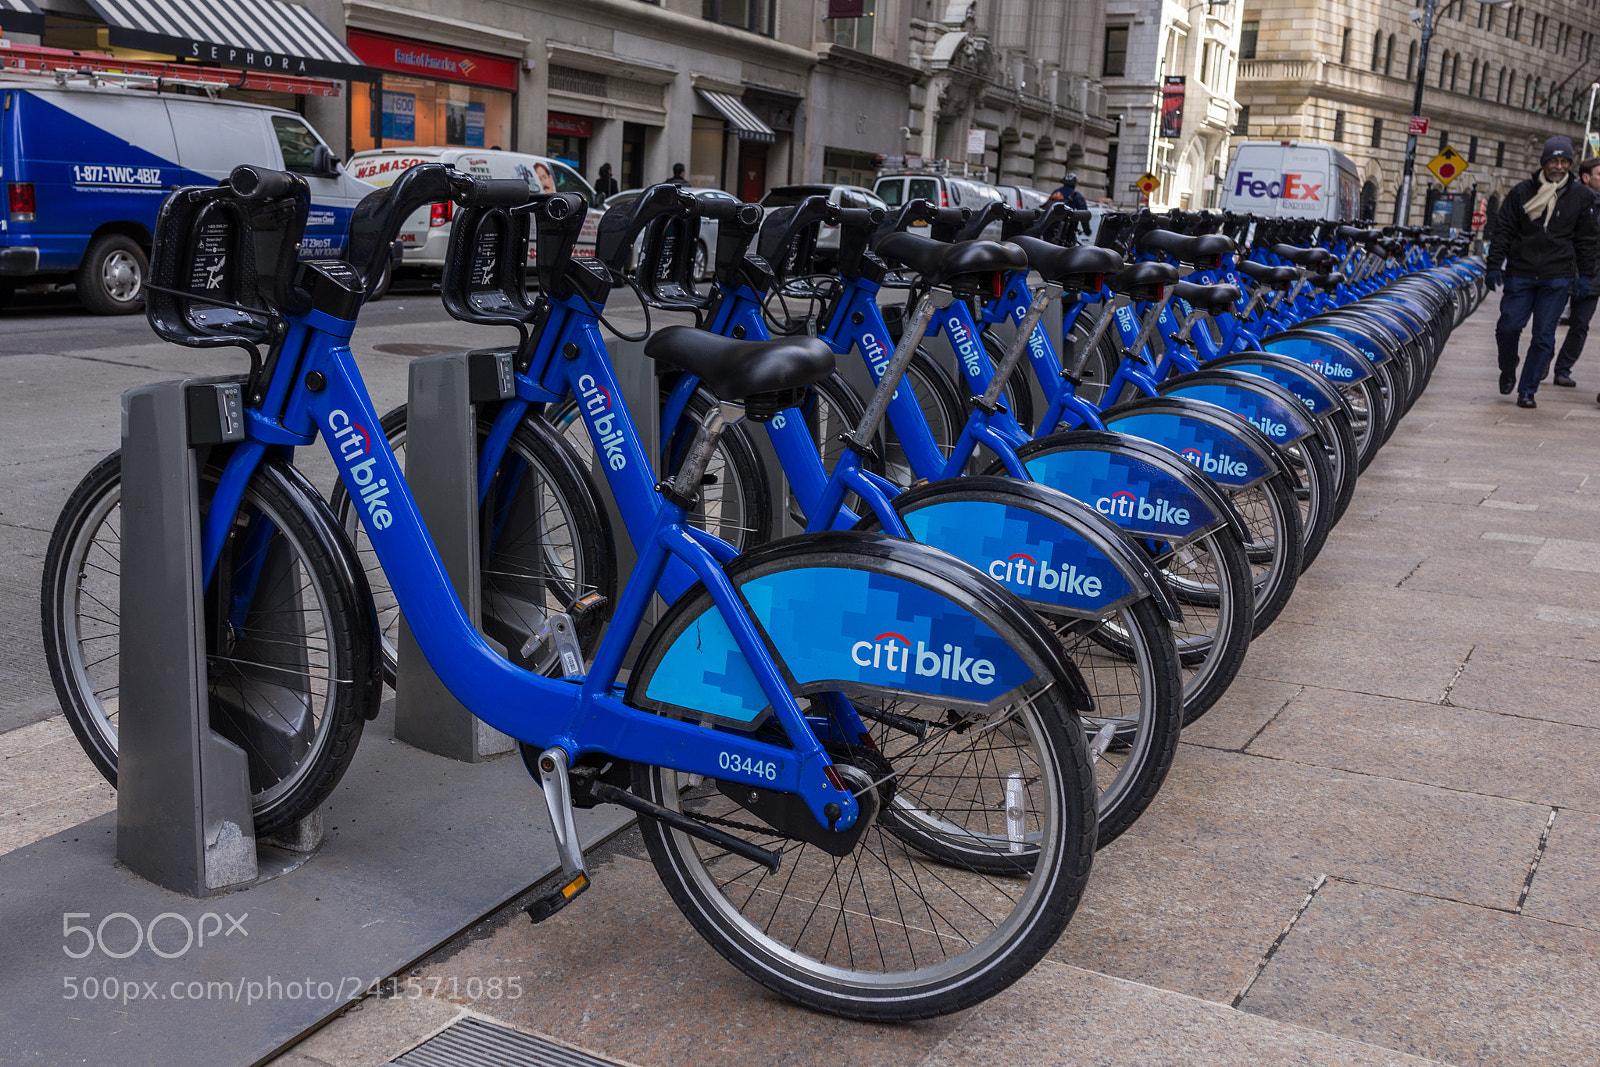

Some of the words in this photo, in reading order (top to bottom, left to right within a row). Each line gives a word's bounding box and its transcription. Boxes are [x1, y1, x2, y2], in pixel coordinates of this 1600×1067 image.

[192, 43, 306, 72] SEPHORA
[394, 48, 416, 65] Bank
[416, 53, 426, 67] of
[425, 54, 457, 72] America
[73, 165, 162, 184] 1-877-TWC-4BIZ
[357, 158, 430, 178] W.B.MASO
[1235, 171, 1322, 201] FedEx
[948, 317, 970, 344] citi
[1115, 307, 1132, 333] bike
[862, 333, 888, 362] citi
[958, 337, 981, 377] bike
[1324, 363, 1353, 377] bike
[578, 374, 611, 417] citi
[594, 412, 627, 471] bike
[328, 409, 371, 462] citi
[350, 457, 393, 530] bike
[1203, 453, 1248, 477] bike
[1096, 491, 1137, 518] citi
[1137, 497, 1191, 525] bike
[989, 553, 1037, 586] citi
[1038, 561, 1102, 598] bike
[852, 632, 912, 672] citi
[915, 641, 996, 685] bike
[719, 751, 777, 781] 03446
